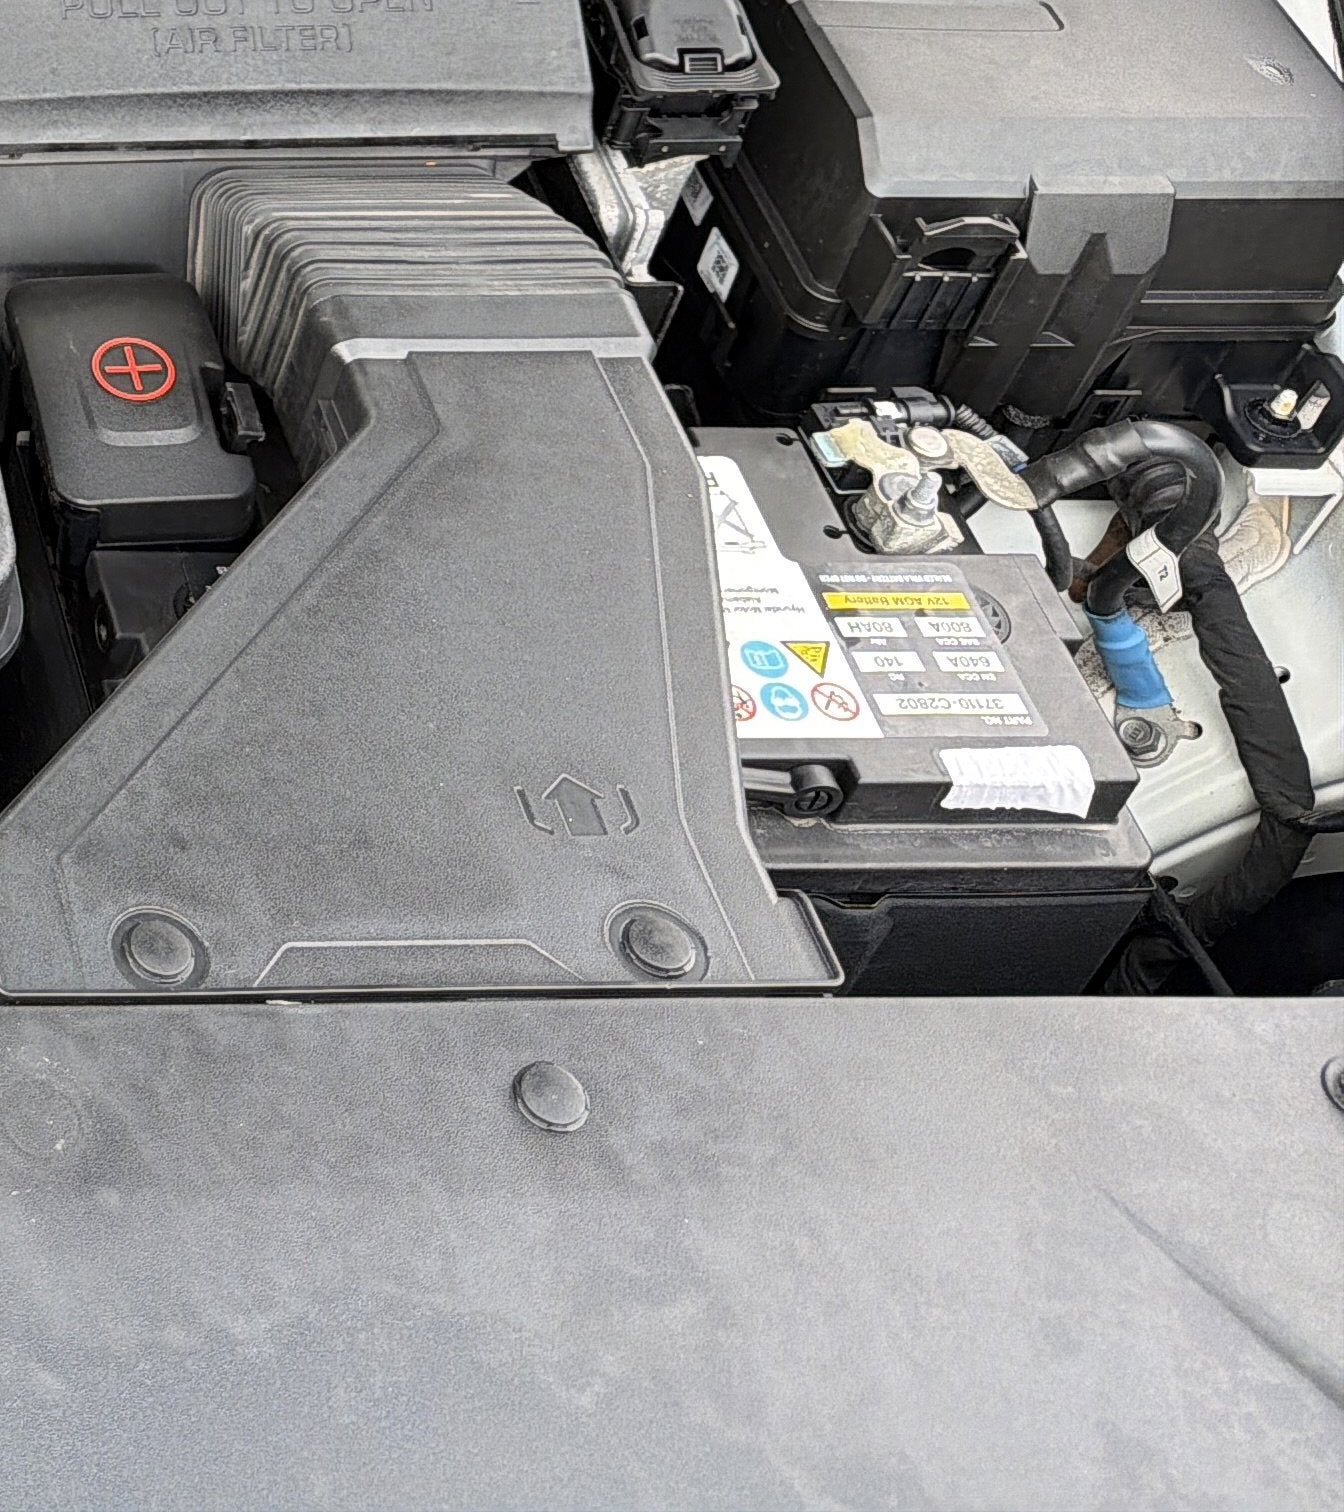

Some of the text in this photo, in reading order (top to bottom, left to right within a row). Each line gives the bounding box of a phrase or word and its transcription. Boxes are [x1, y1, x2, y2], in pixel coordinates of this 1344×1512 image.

[844, 595, 950, 607] 12V AGM Battery
[847, 621, 894, 633] 80AH
[874, 655, 904, 668] 140
[946, 655, 992, 668] 640A
[897, 697, 1005, 710] 37110-C2802
